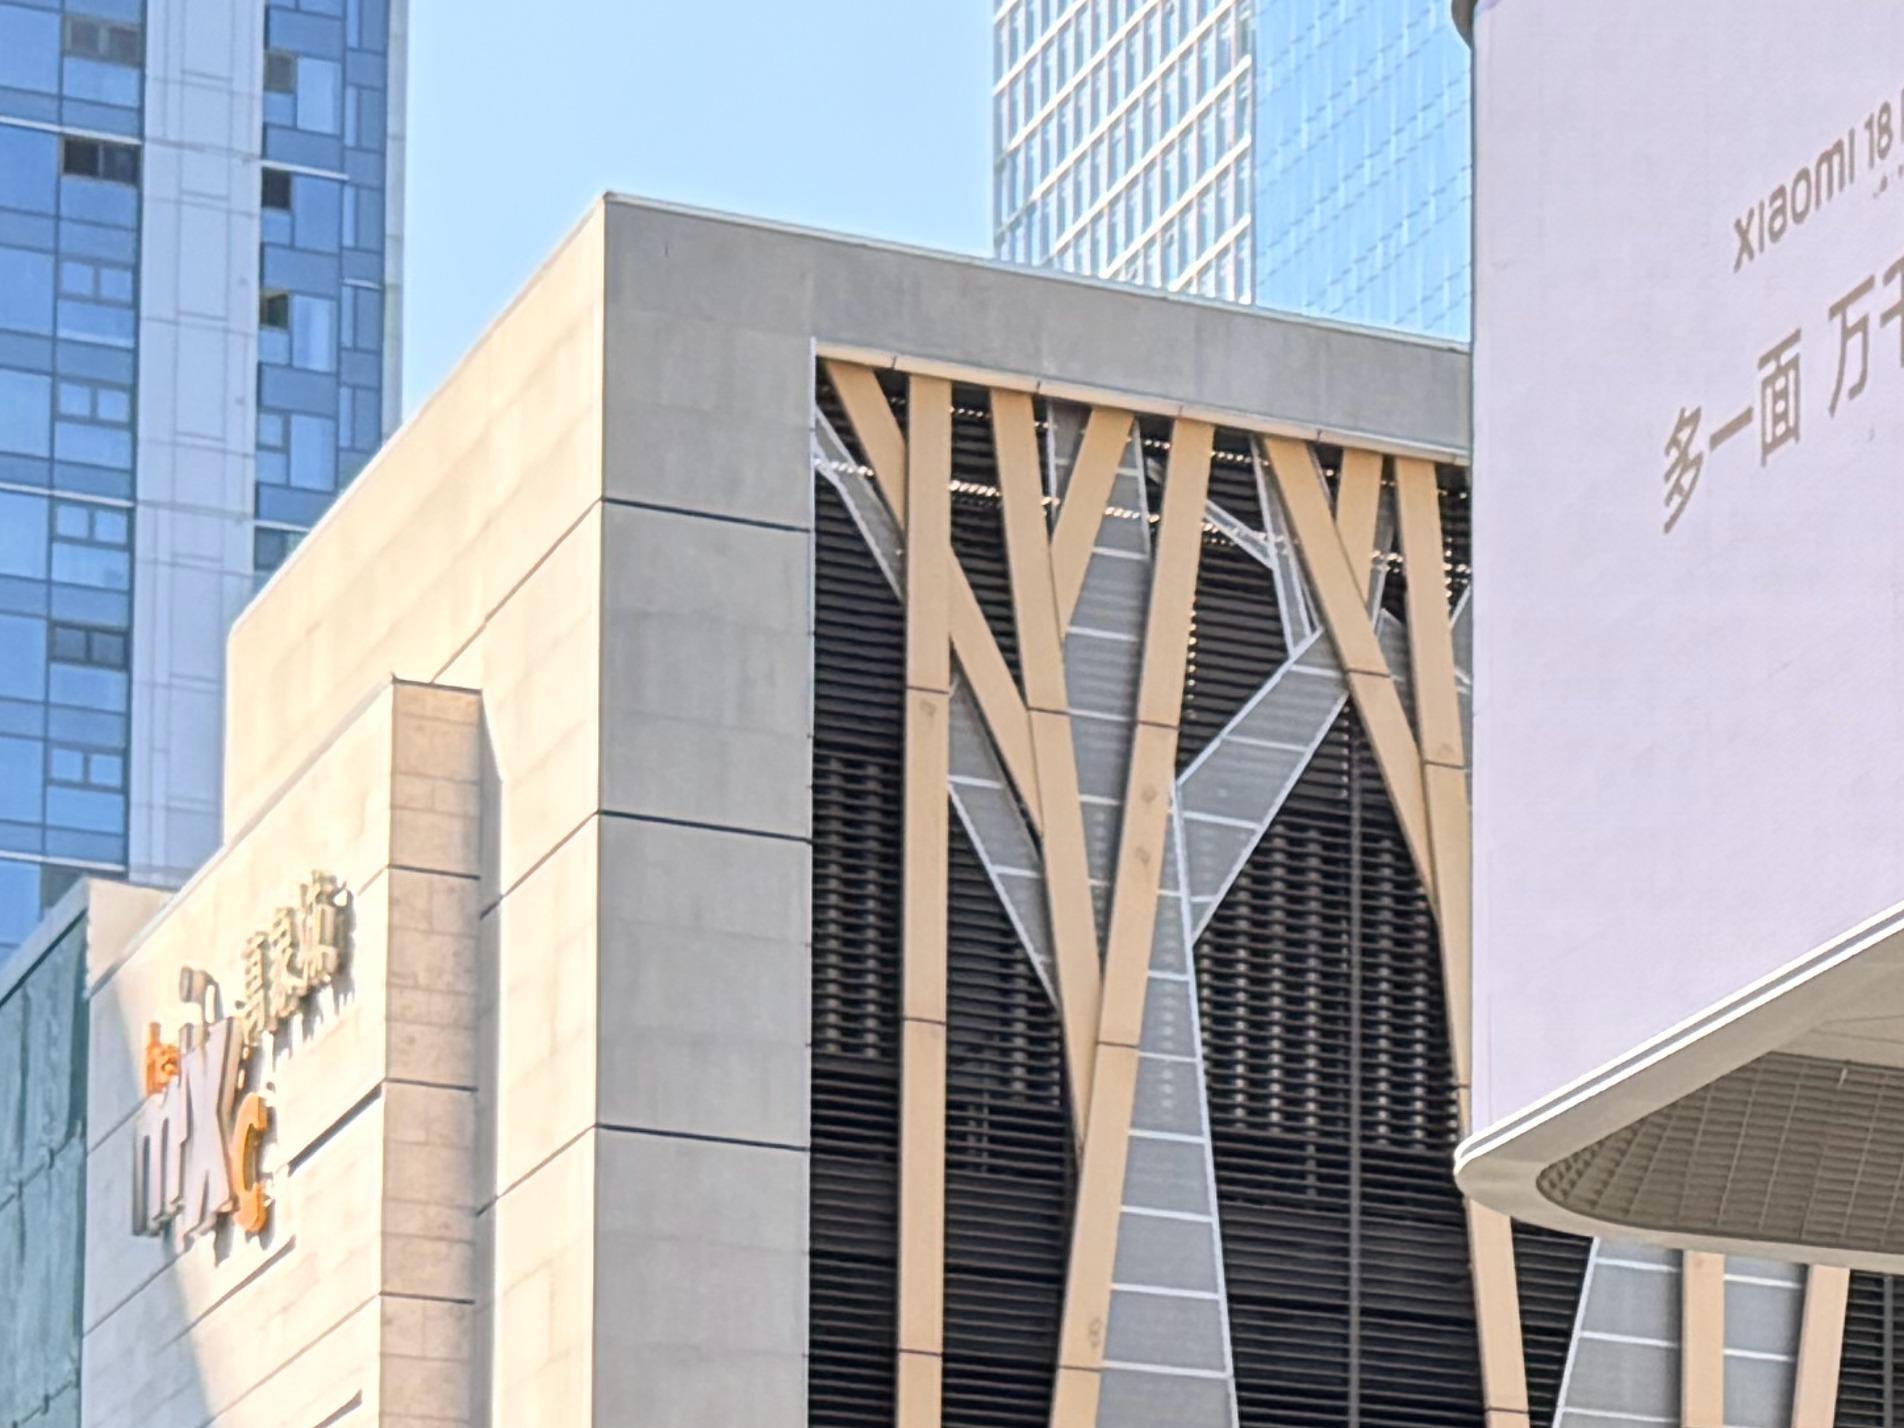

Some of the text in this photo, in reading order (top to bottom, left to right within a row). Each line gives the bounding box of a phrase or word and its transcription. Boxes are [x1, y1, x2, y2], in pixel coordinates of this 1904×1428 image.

[1733, 127, 1856, 273] xiaomi
[1864, 100, 1894, 172] 18
[1663, 327, 1802, 534] 多一面
